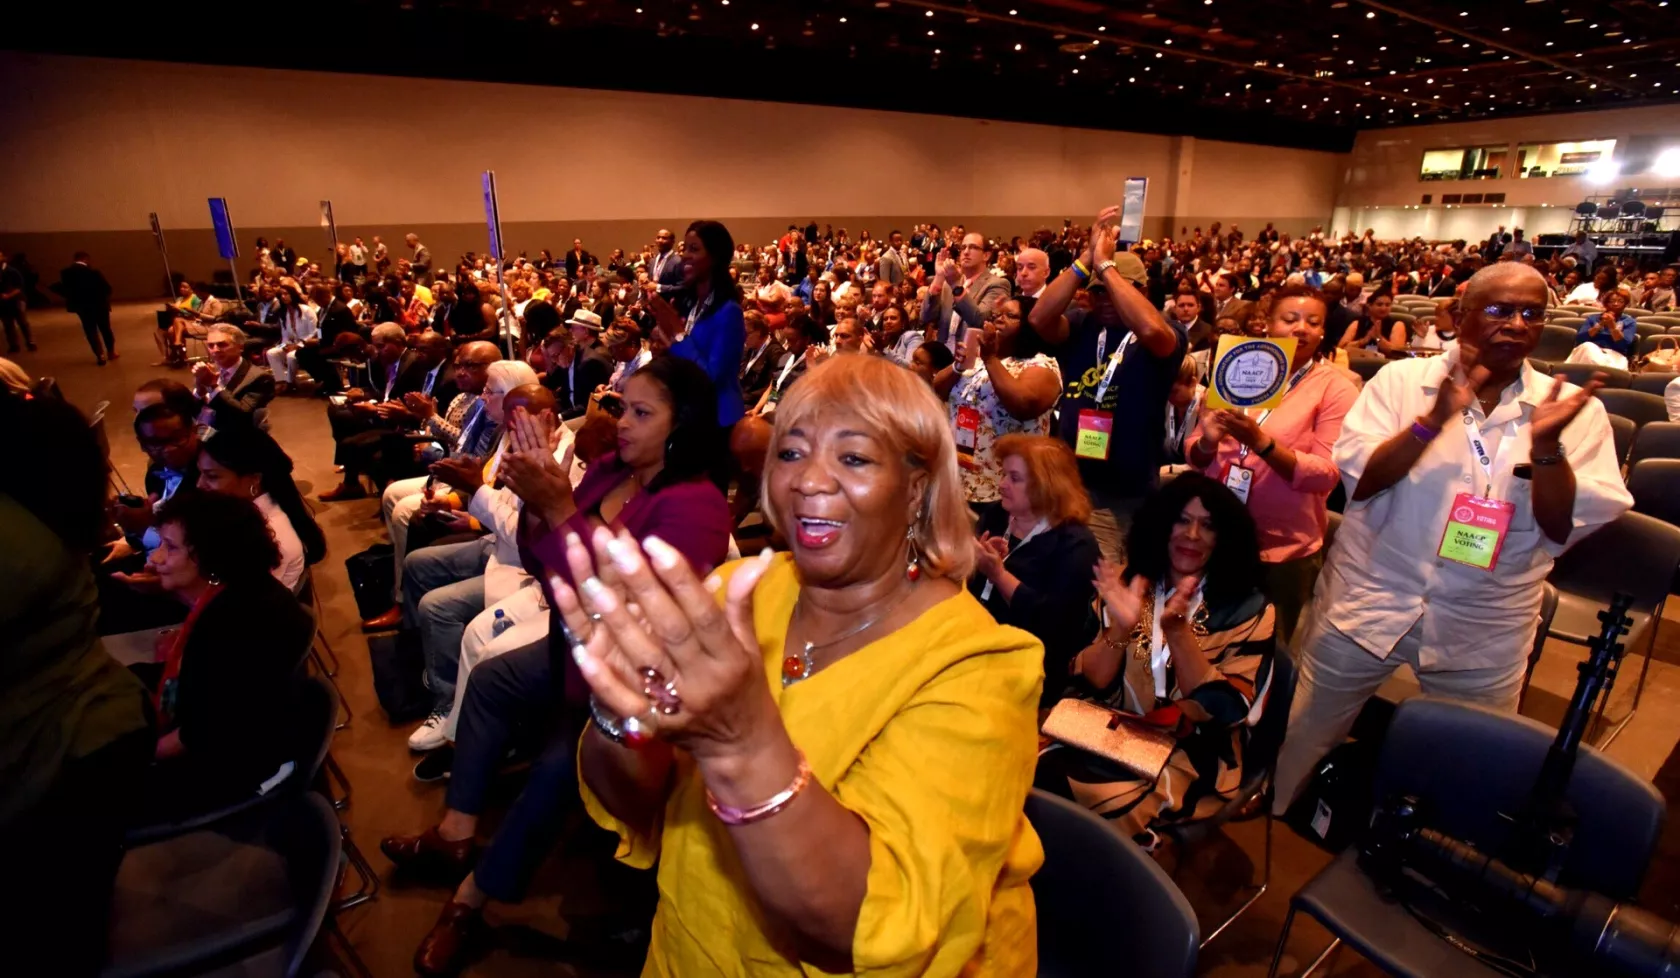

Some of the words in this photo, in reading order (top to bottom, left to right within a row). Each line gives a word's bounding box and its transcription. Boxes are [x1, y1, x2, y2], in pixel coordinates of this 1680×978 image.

[1244, 343, 1256, 351] THE
[1472, 439, 1485, 457] NAACP
[1476, 515, 1497, 525] VOTING
[1456, 530, 1487, 541] NAACP
[1454, 538, 1484, 551] VOTING
